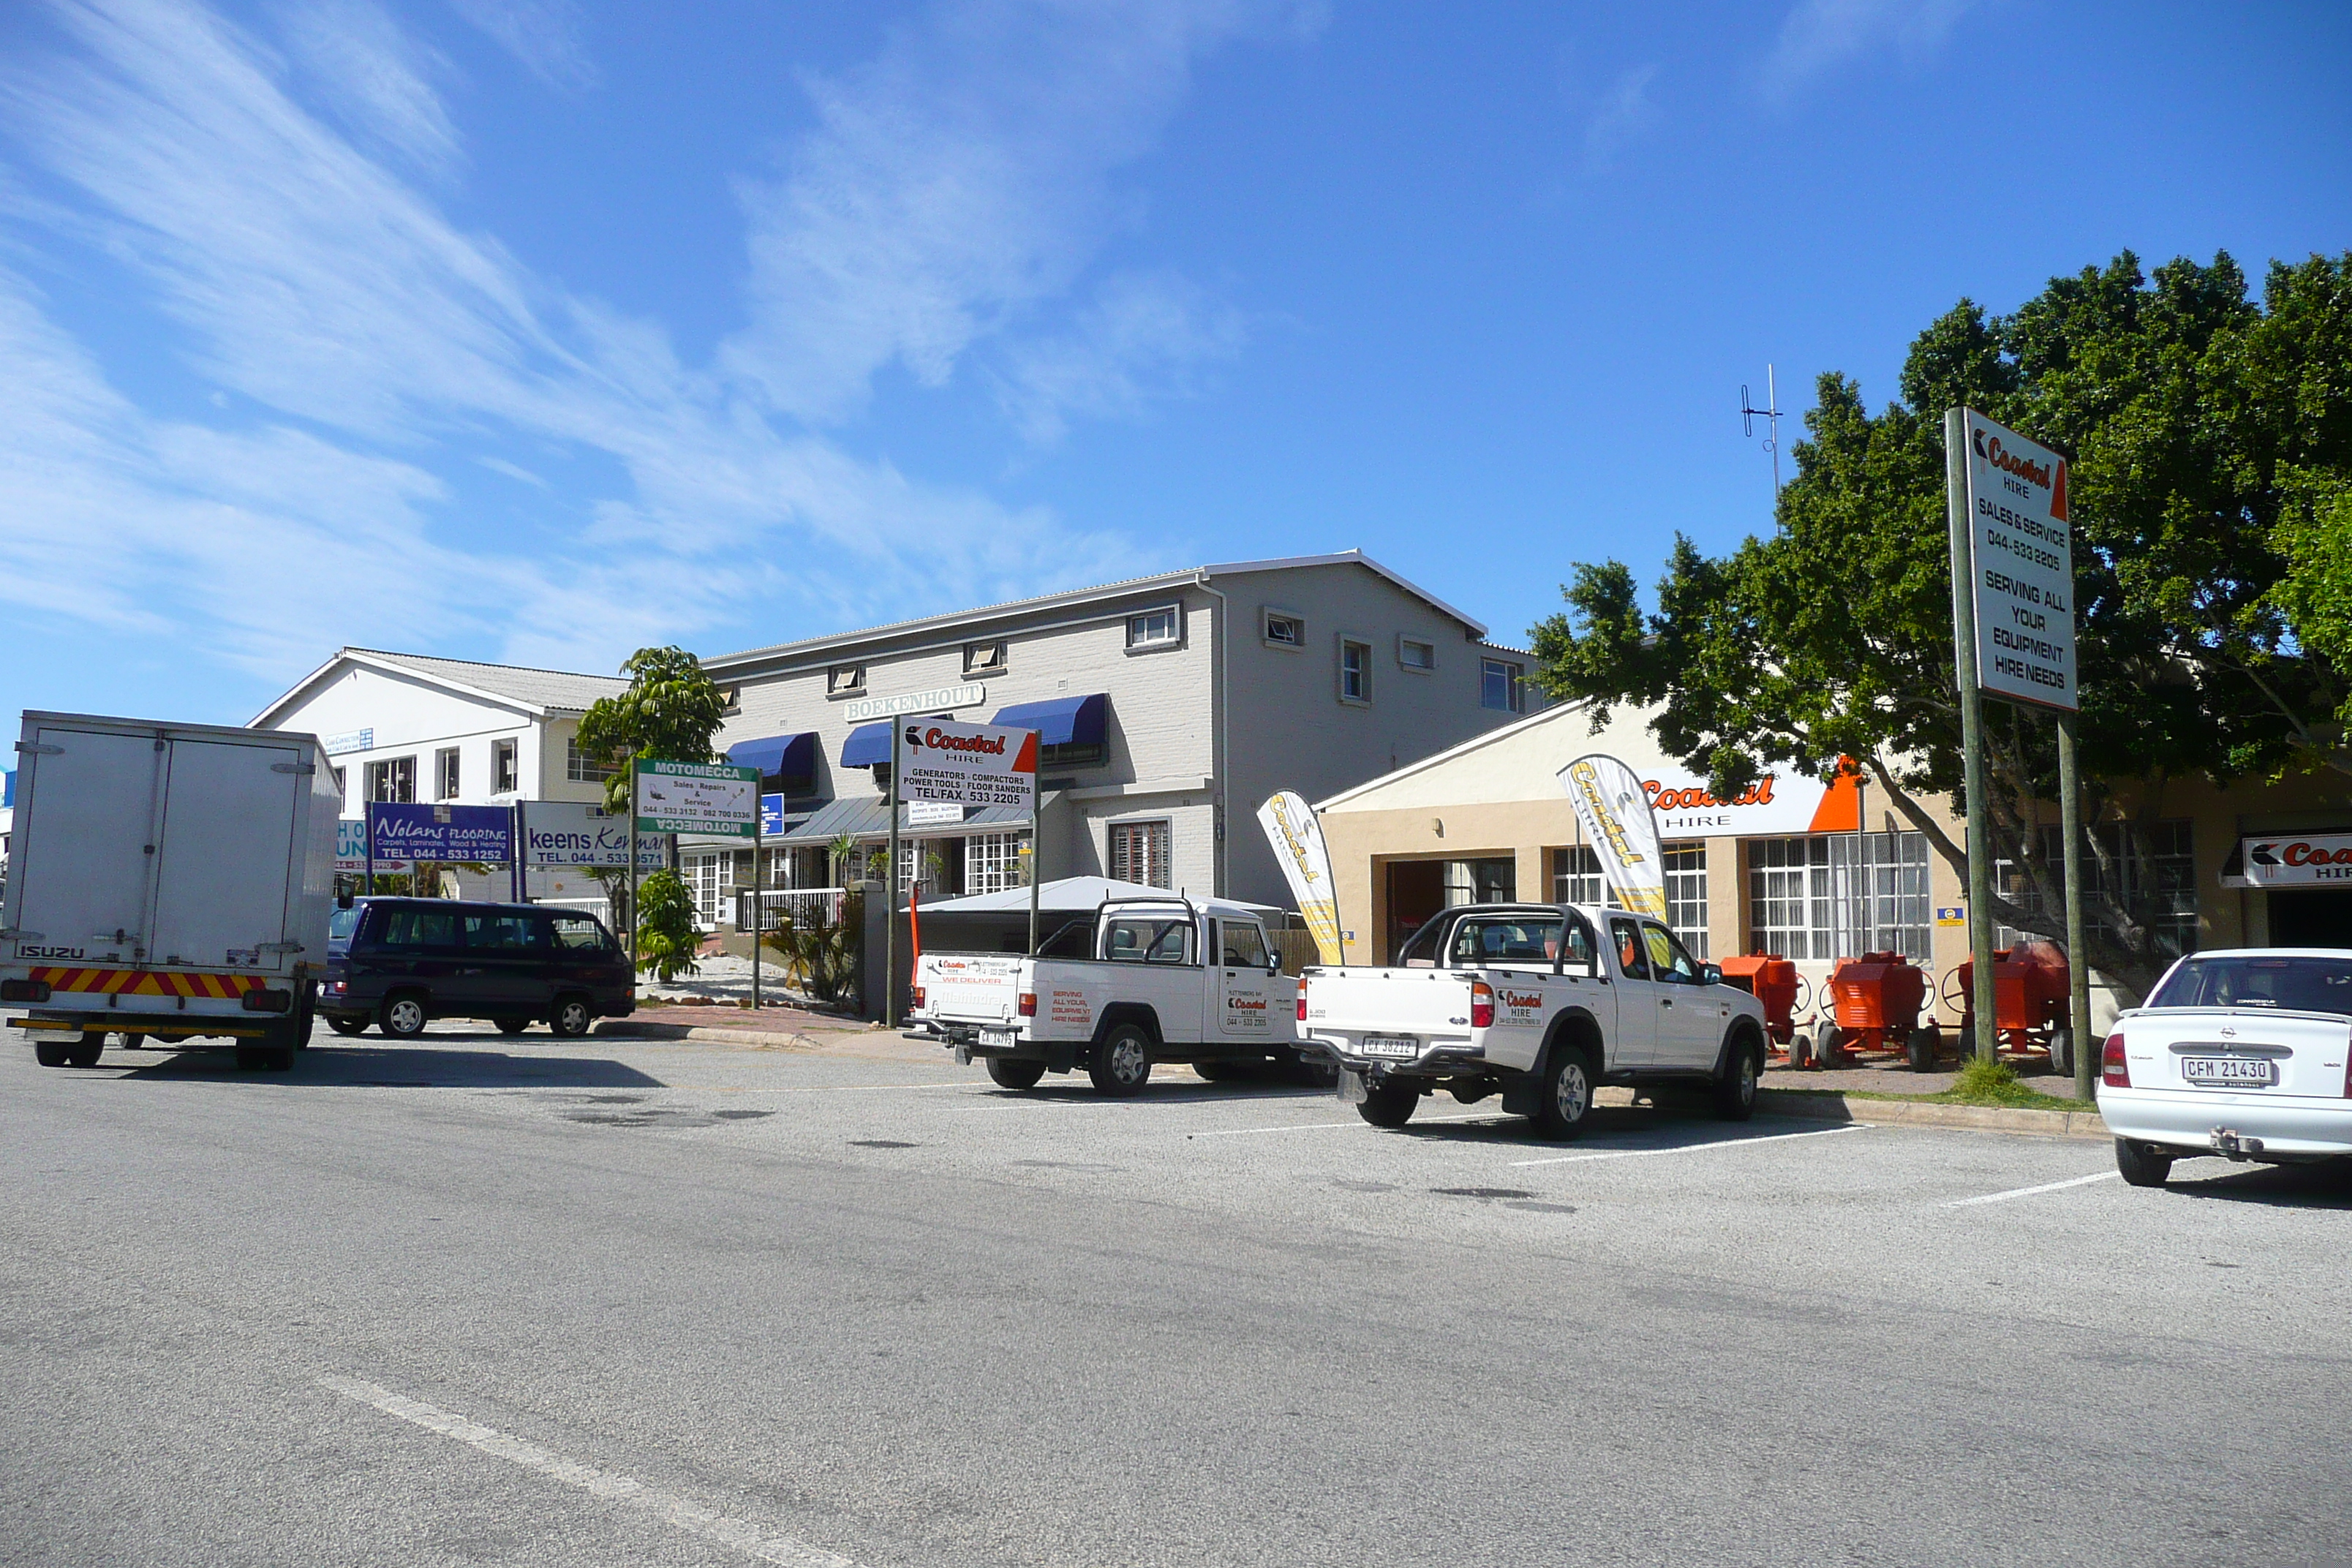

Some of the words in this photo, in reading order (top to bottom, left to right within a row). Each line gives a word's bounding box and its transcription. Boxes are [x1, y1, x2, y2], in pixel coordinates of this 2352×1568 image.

[1988, 437, 2051, 490] Coastal
[2003, 477, 2029, 500] HIRE
[1979, 497, 2013, 527] SALES
[2014, 513, 2022, 530] &
[2023, 518, 2065, 548] SERVICE
[2035, 549, 2060, 571] 2205
[1986, 570, 2040, 603] SERVING
[2044, 591, 2066, 612] ALL
[2011, 605, 2046, 632] YOUR
[1993, 627, 2064, 663] EQUIPMENT
[1995, 655, 2024, 679] HIRE
[2025, 664, 2065, 689] NEEDS
[847, 685, 980, 719] BOEKENHOUT
[925, 728, 1006, 755] Coastal
[946, 754, 984, 764] HIRE
[655, 761, 740, 780] MOTOMECCA
[912, 769, 965, 780] GENERATORS
[972, 773, 1025, 785] COMPACTORS
[674, 781, 694, 789] Sales
[699, 782, 726, 791] Repairs
[903, 777, 933, 787] POWER
[935, 779, 961, 788] TOOLS
[967, 782, 993, 791] FLOOR
[995, 784, 1031, 795] SANDERS
[684, 799, 712, 807] Service
[969, 791, 990, 803] 533
[993, 793, 1020, 804] 2205
[679, 807, 698, 815] 3132
[704, 809, 717, 817] 082
[718, 810, 731, 818] 700
[733, 810, 750, 818] 0336
[1570, 761, 1646, 869] Coastal
[376, 817, 445, 840] Nolans
[1666, 815, 1731, 828] HIRE
[449, 828, 507, 840] FLOORING
[529, 828, 592, 850] keens
[449, 840, 470, 848] Wood
[480, 840, 507, 849] Heating
[382, 848, 411, 859] TEL.
[414, 848, 437, 859] 044
[448, 849, 470, 859] 533
[473, 850, 502, 860] 1252
[538, 852, 568, 863] TEL.
[571, 853, 595, 863] 044
[607, 853, 630, 864] 533
[2283, 843, 2352, 867] Coa
[2315, 867, 2352, 878] HIR
[20, 946, 84, 959] ISUZU
[1235, 998, 1267, 1010] Coastal
[1507, 990, 1542, 1009] Coastal
[1511, 1009, 1531, 1017] HIRE
[1368, 1039, 1380, 1052] CX
[1382, 1040, 1411, 1053] 38212
[2188, 1061, 2214, 1077] CFM
[2222, 1061, 2266, 1078] 21430
